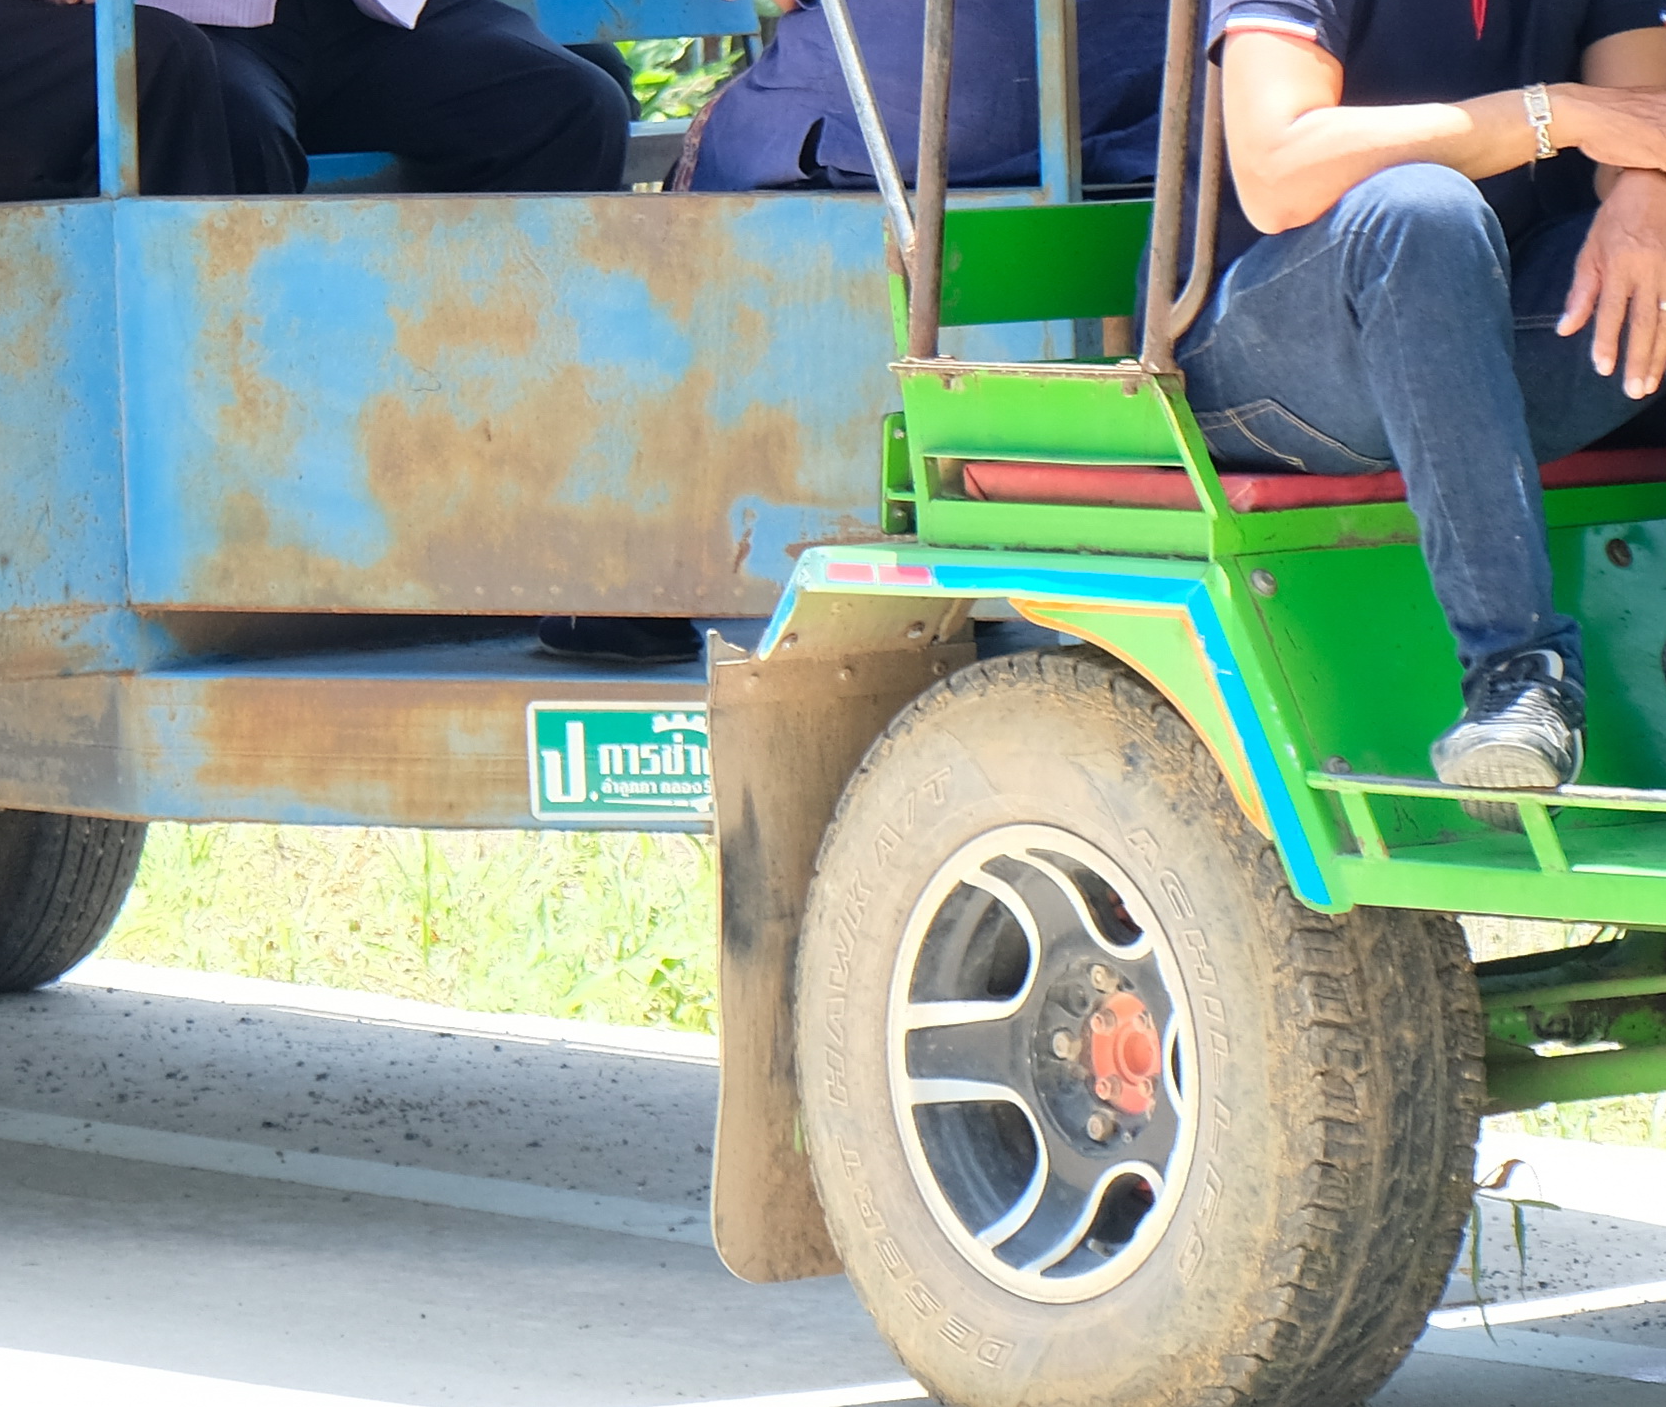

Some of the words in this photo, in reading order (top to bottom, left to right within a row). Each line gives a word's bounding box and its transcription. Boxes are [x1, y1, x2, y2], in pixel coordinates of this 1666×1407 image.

[822, 869, 873, 1108] HAWK
[1126, 827, 1232, 1288] ACHILLES
[836, 1134, 1017, 1370] DESERT
